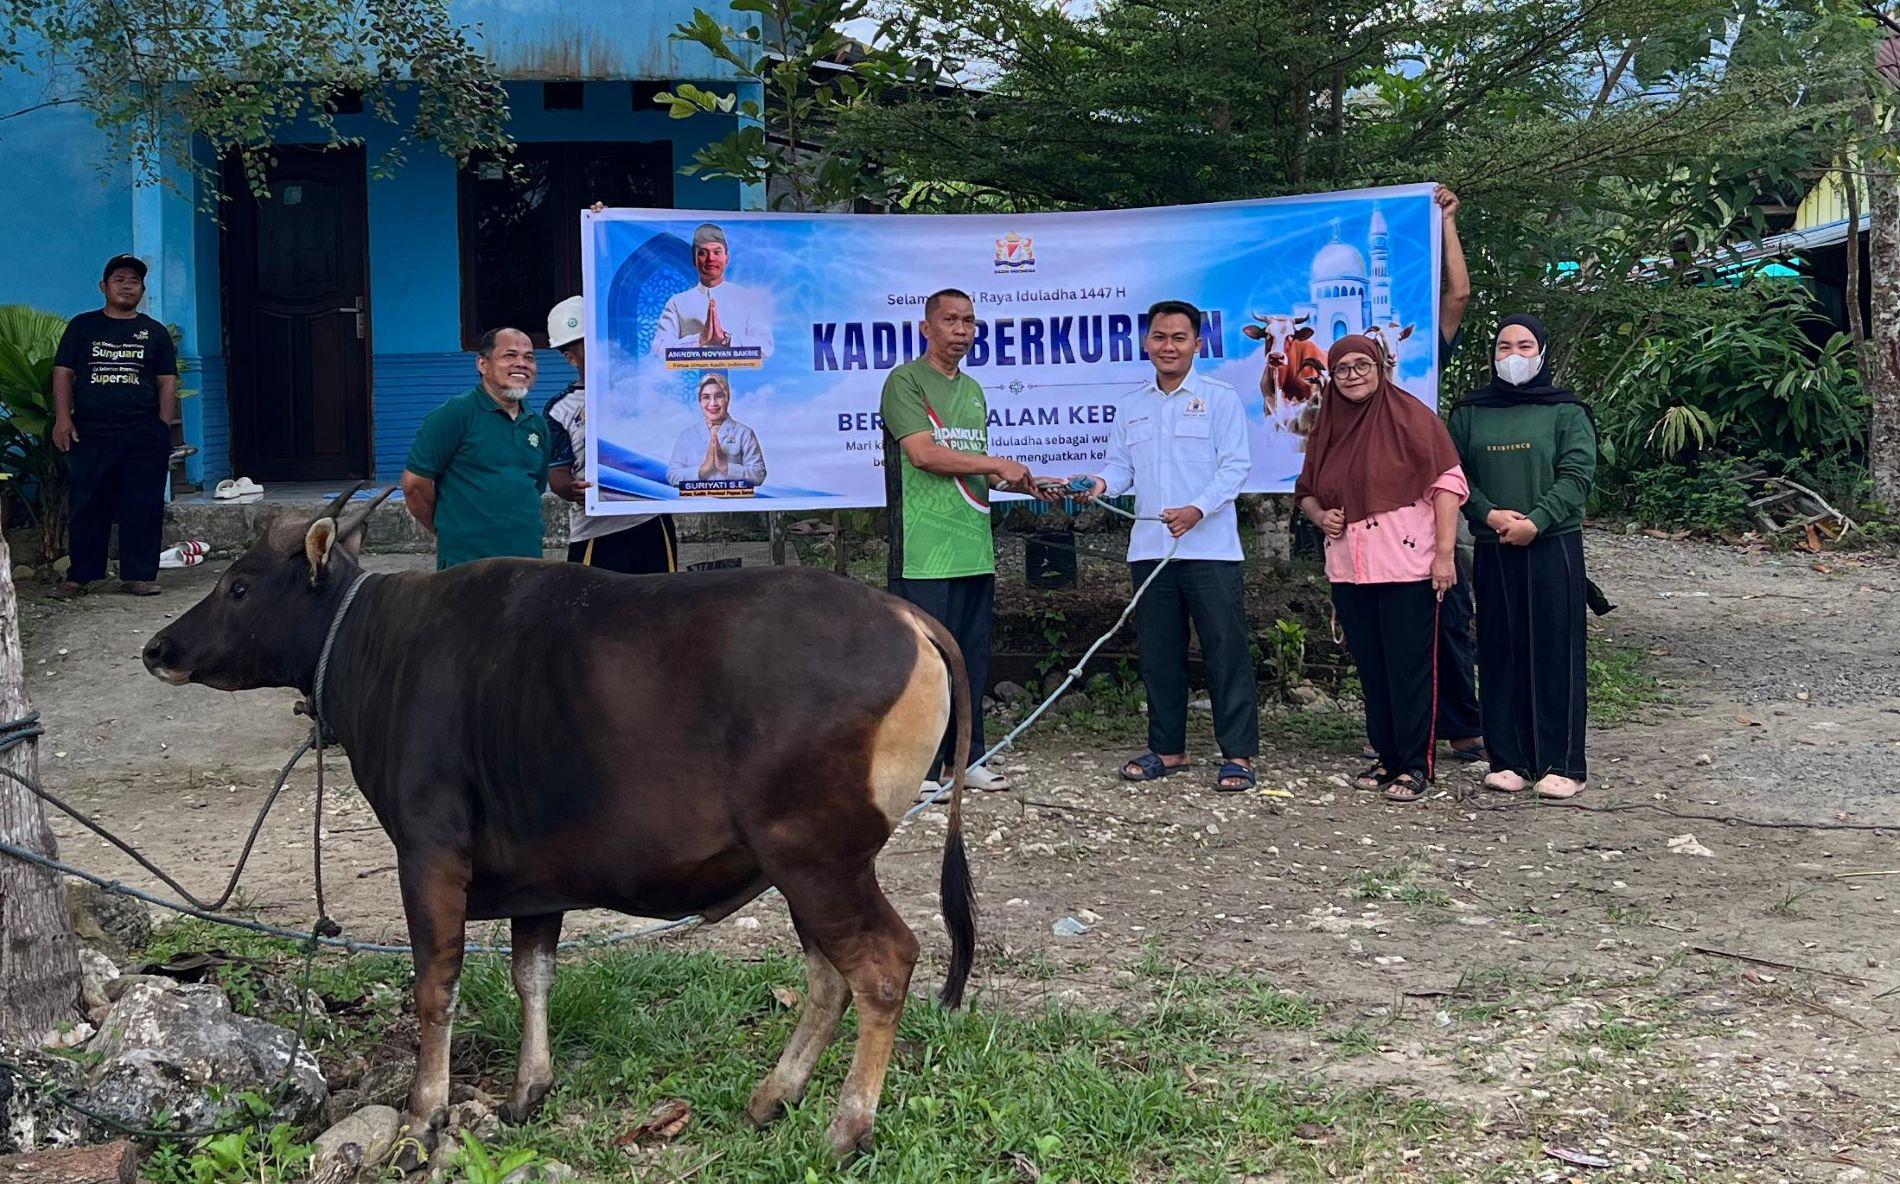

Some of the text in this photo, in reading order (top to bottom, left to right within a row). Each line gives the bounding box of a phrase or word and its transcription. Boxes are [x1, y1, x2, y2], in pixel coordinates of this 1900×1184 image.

[887, 293, 928, 305] Selam
[980, 291, 1011, 305] Raya
[1016, 288, 1077, 302] Iduladha
[1080, 287, 1111, 299] 1447
[1116, 287, 1127, 298] H
[92, 346, 144, 360] Sunguard
[812, 321, 927, 371] KADI
[90, 372, 140, 385] Supersilk
[986, 406, 1059, 427] ALAM
[846, 440, 872, 451] Mari
[991, 435, 1042, 447] Iduladha
[1045, 433, 1089, 447] sebagai
[1016, 450, 1087, 465] menguatkan
[685, 481, 747, 490] SURIYATI S.E.
